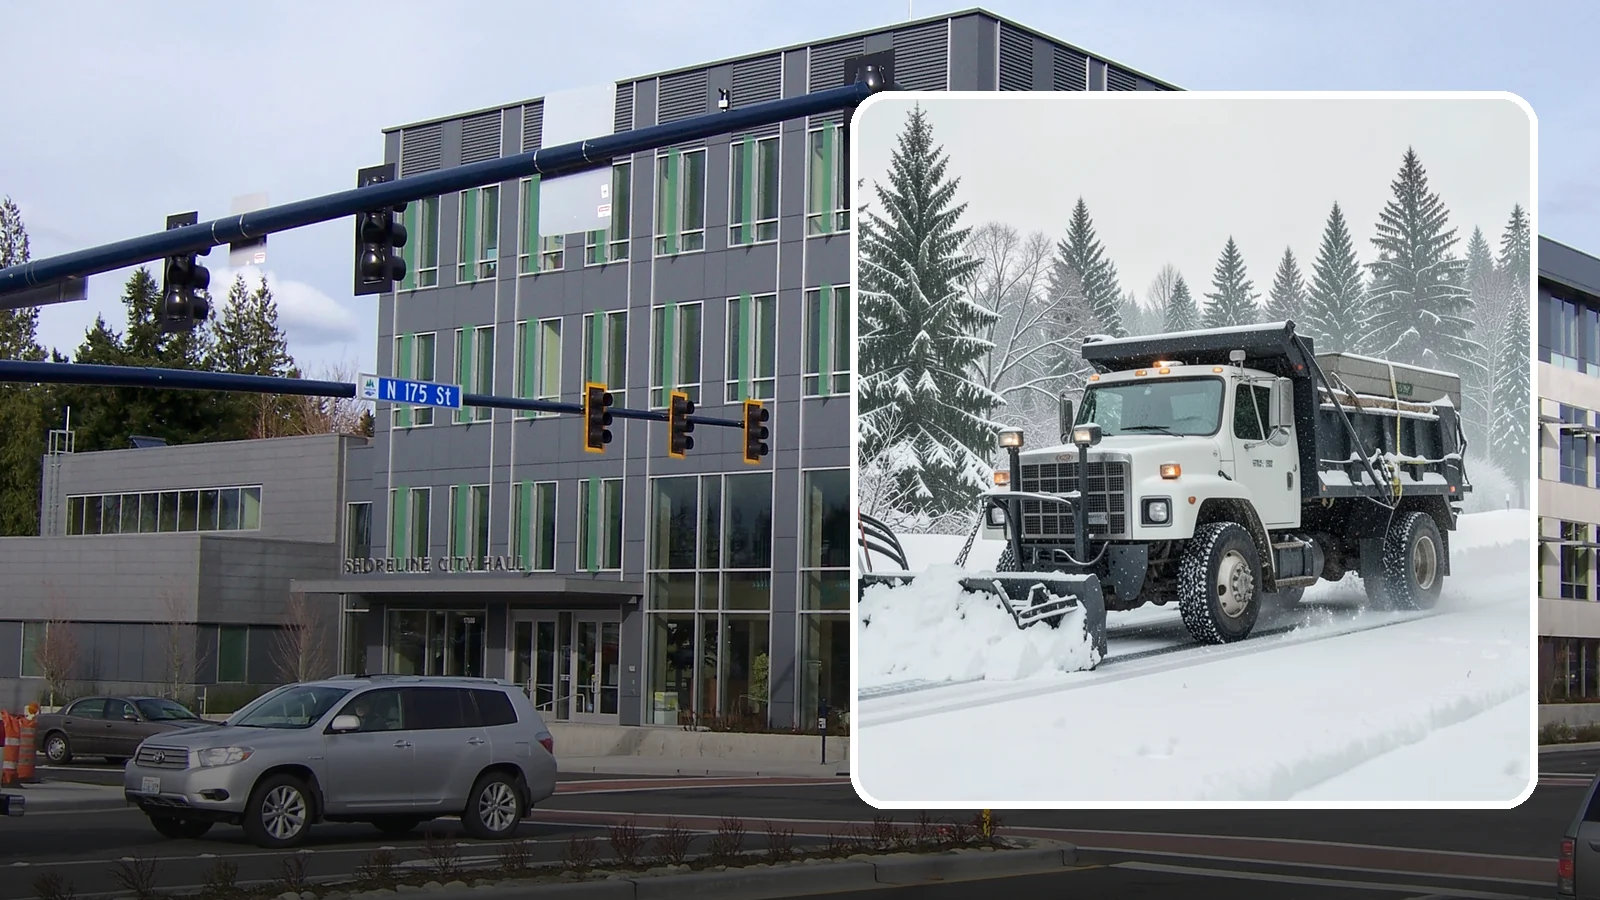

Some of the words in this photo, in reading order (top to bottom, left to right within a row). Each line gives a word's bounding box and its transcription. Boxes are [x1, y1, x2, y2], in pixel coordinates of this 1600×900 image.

[387, 380, 396, 400] N
[405, 382, 428, 403] 175
[436, 386, 451, 406] St
[344, 556, 432, 574] SHORELINE
[438, 556, 476, 573] CITY
[484, 555, 526, 572] HALL
